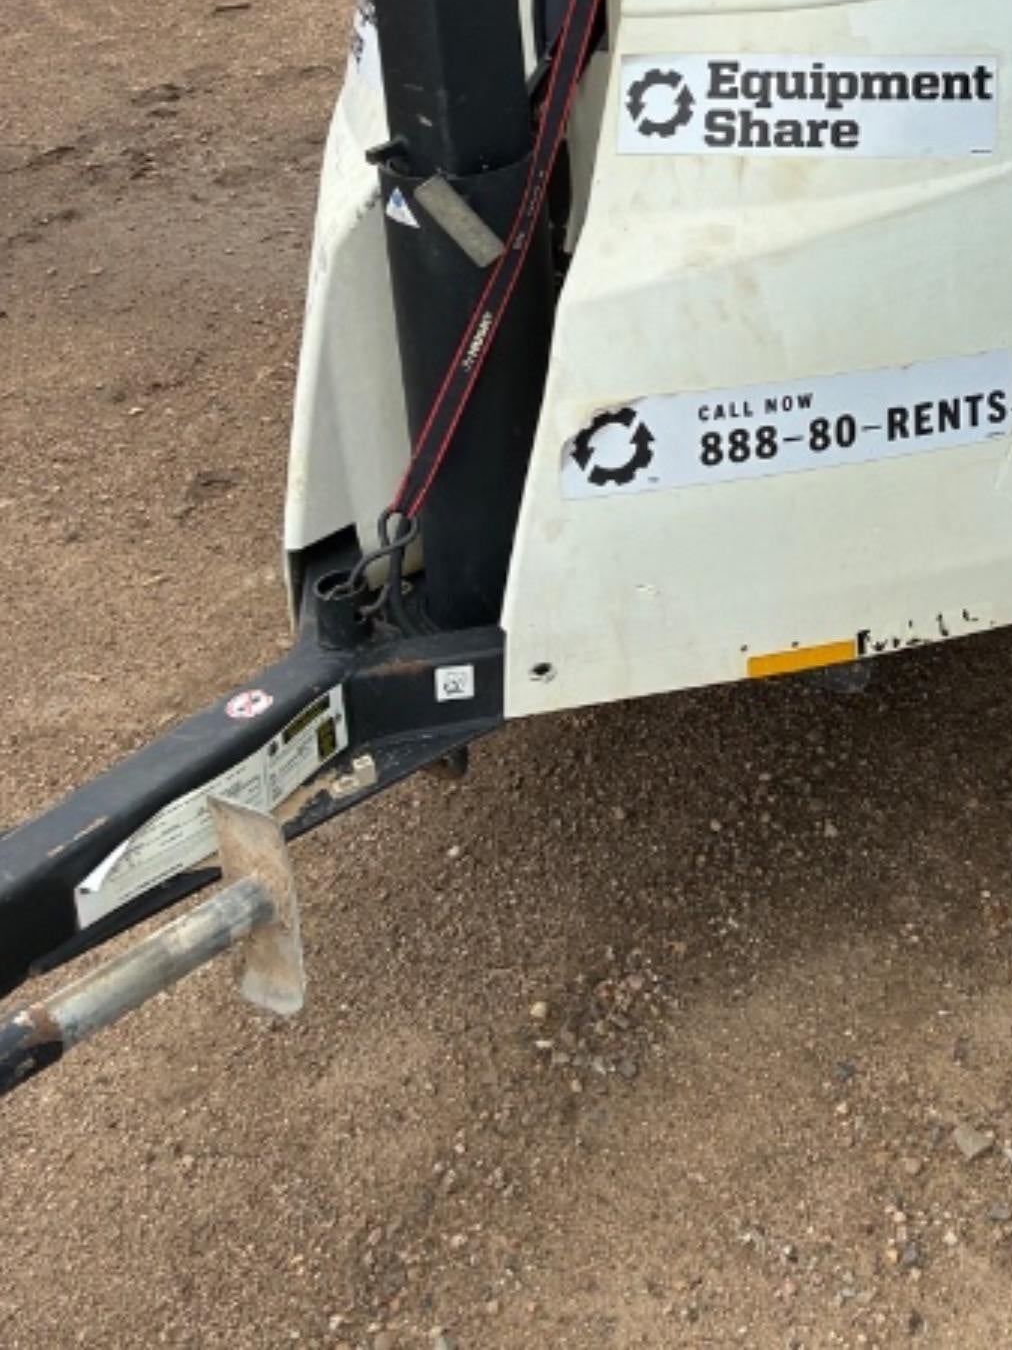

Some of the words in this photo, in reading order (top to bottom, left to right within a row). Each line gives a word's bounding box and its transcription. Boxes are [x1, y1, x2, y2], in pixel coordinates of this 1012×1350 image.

[706, 60, 993, 109] Equipment
[703, 108, 860, 149] Share
[698, 401, 754, 422] CALL
[764, 392, 815, 415] NOW
[700, 389, 1008, 467] 888-80-RENTS
